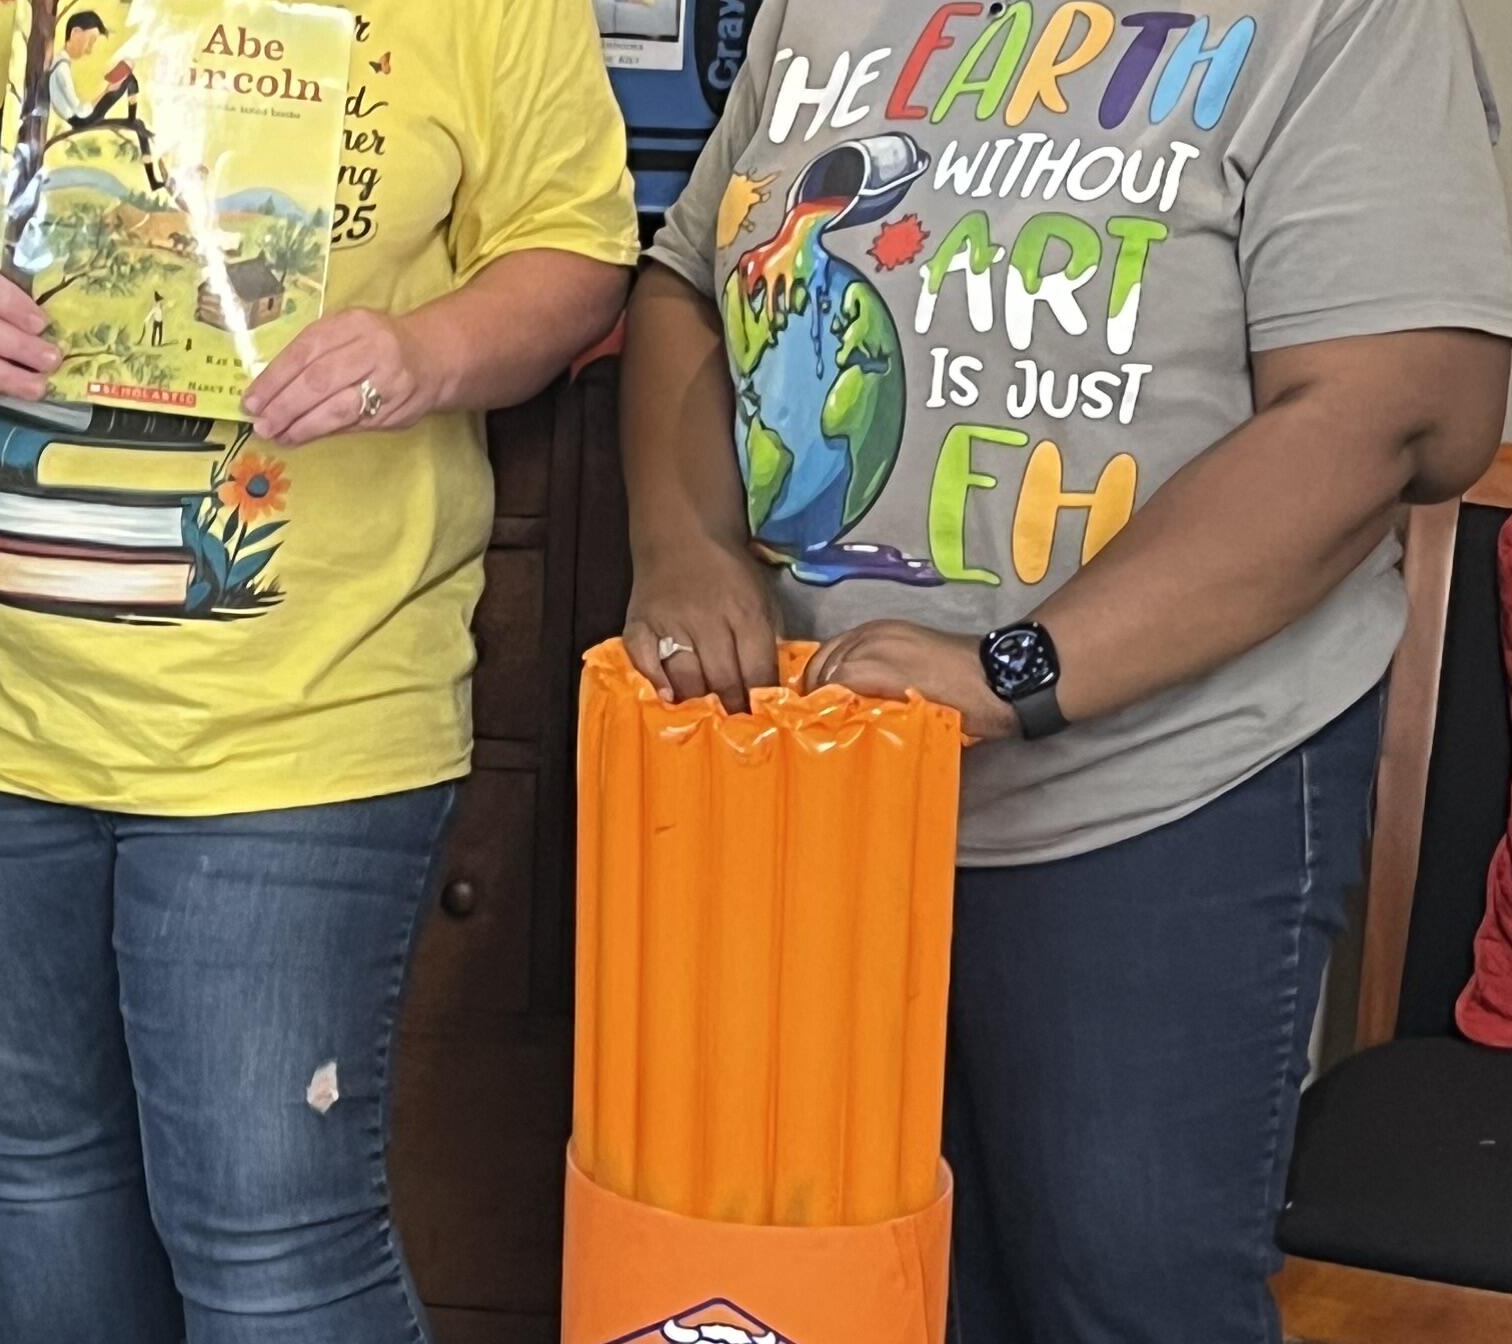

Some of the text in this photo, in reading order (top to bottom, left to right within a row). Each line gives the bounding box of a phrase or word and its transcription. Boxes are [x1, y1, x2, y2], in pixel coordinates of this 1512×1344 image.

[201, 23, 285, 61] Abe
[768, 0, 1258, 145] HE EARTH
[932, 132, 1200, 213] WITHOUT
[914, 210, 1169, 355] ART
[925, 346, 1153, 425] IS JUST
[927, 422, 1139, 586] EH
